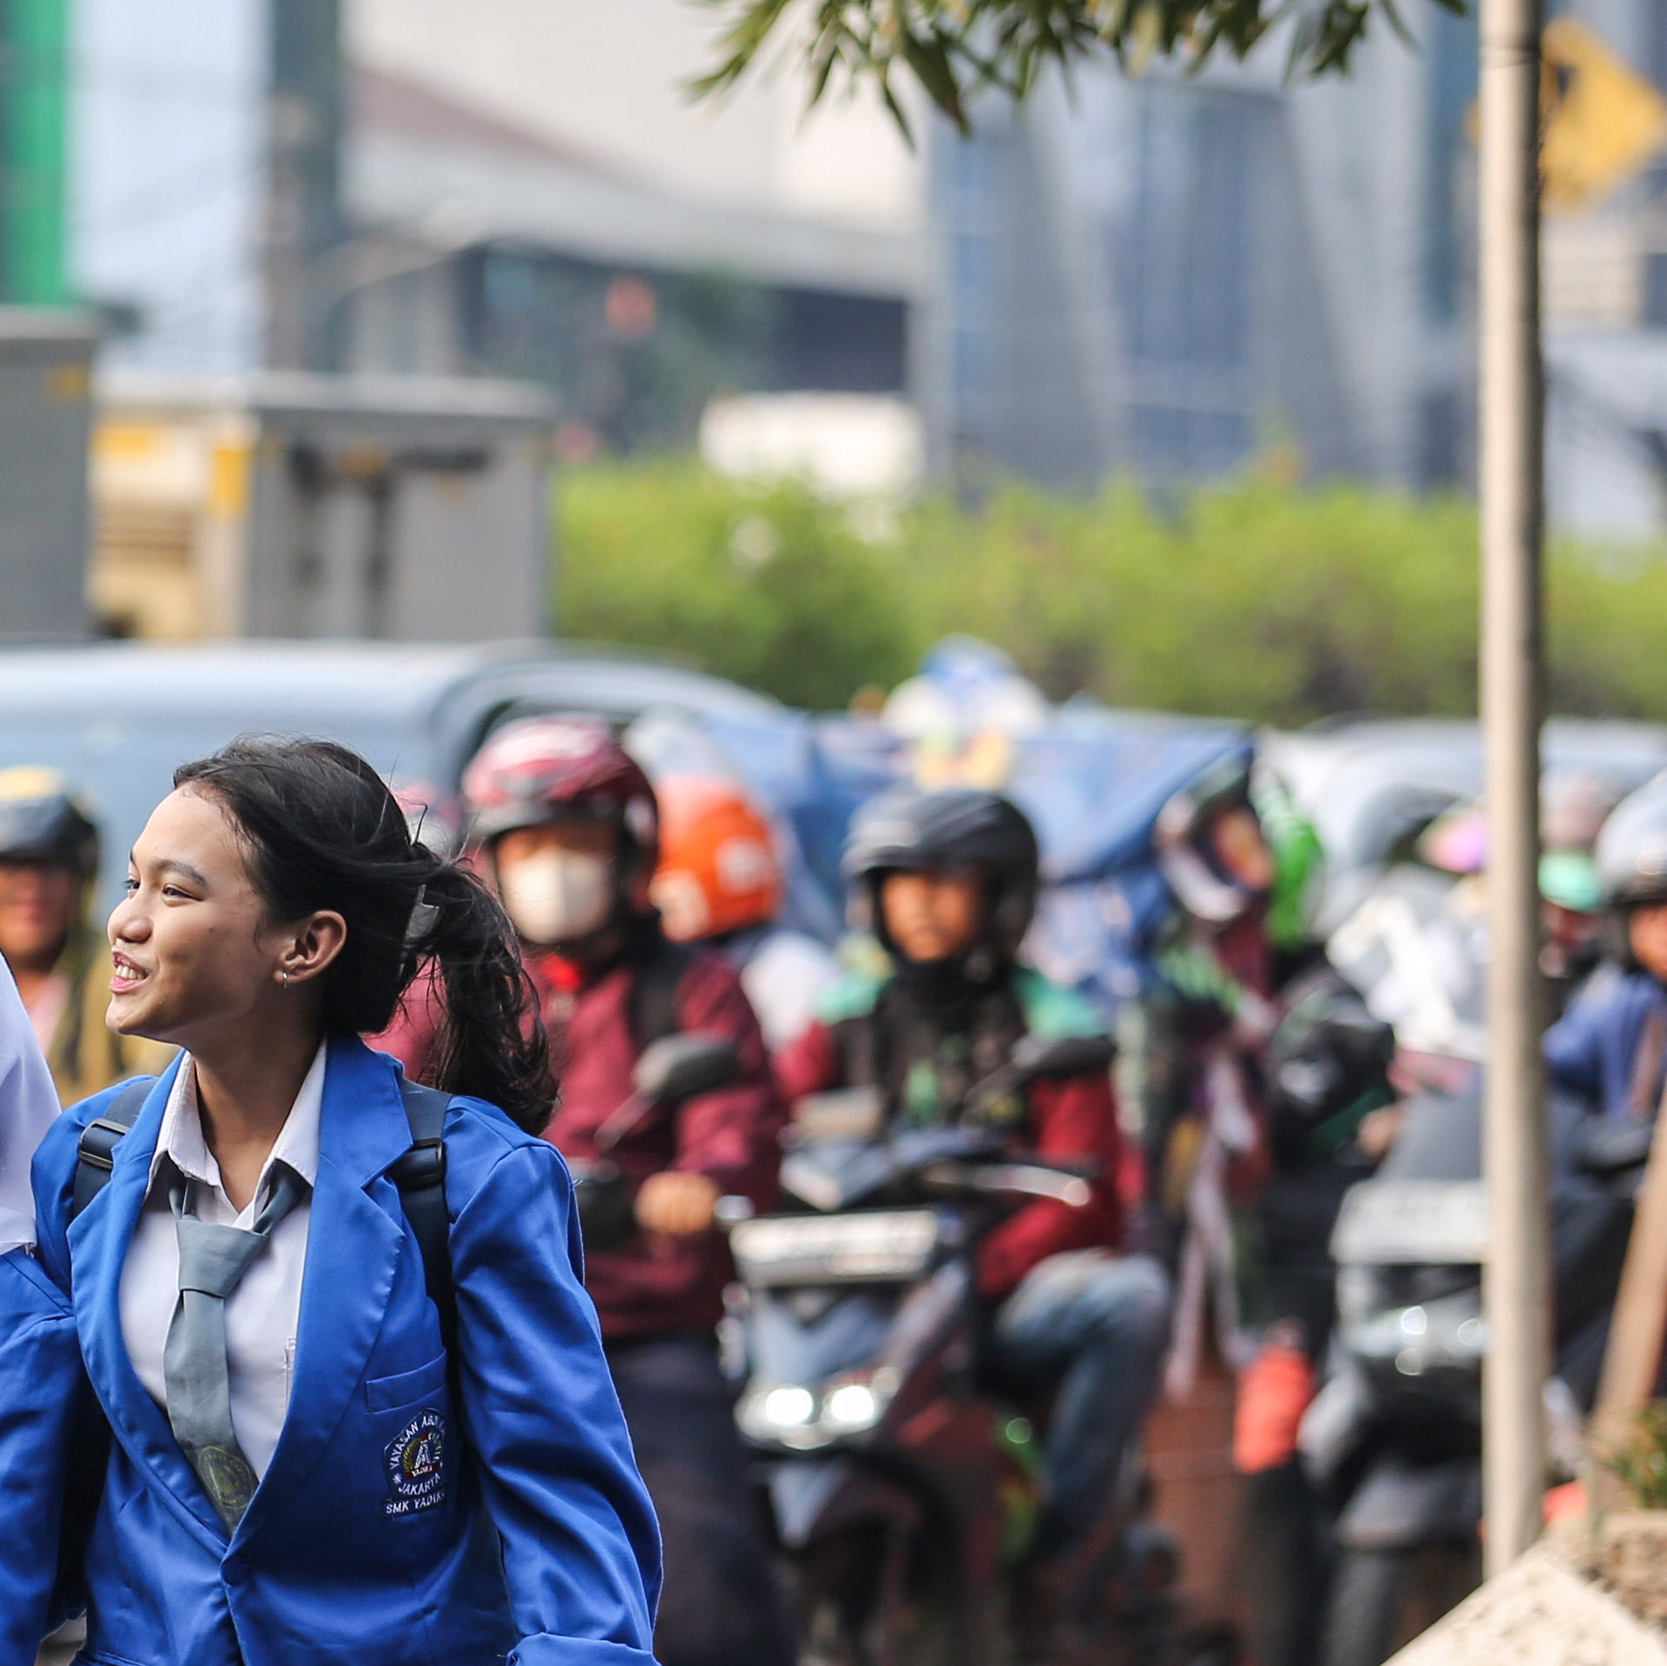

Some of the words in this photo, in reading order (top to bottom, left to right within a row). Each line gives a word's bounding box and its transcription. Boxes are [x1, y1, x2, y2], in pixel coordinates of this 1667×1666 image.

[390, 1421, 419, 1470] YAYASAN
[398, 1472, 441, 1496] JAKARTA
[386, 1500, 409, 1514] SMK
